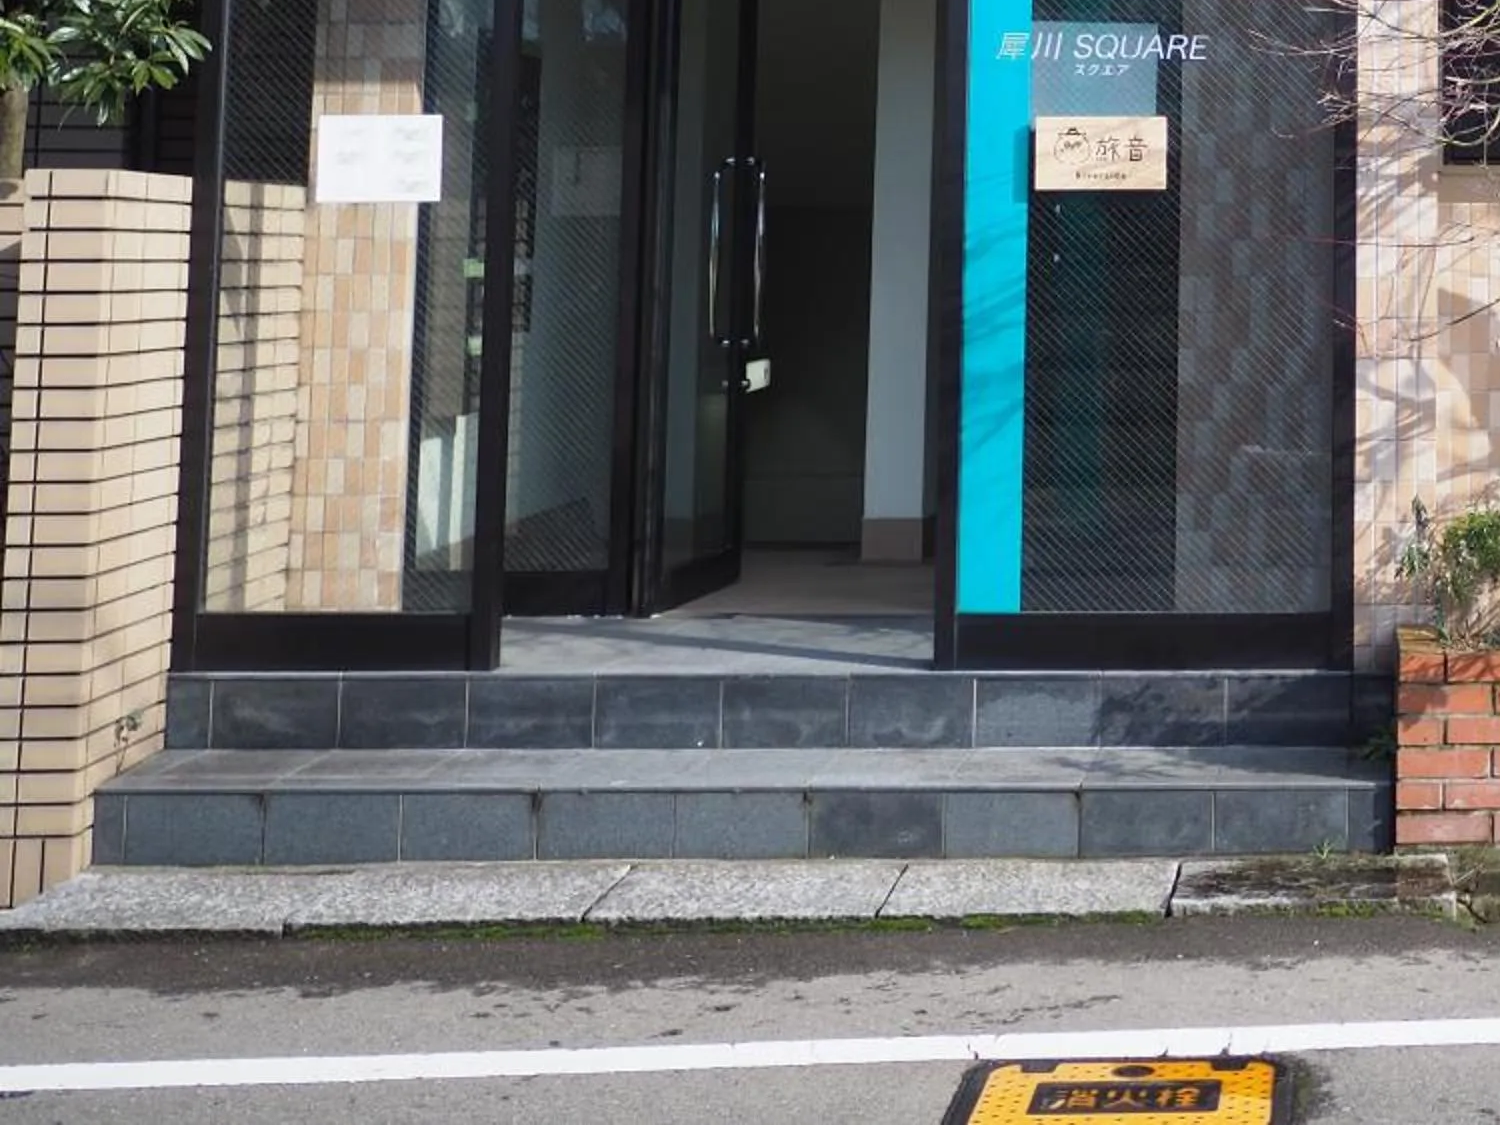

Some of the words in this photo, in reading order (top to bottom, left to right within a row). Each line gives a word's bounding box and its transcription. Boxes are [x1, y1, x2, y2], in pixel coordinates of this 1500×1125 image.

[1074, 33, 1209, 60] SQUARE
[1074, 64, 1129, 76] スクエア
[1095, 135, 1148, 162] 旅音
[1042, 1085, 1201, 1111] 消火栓
